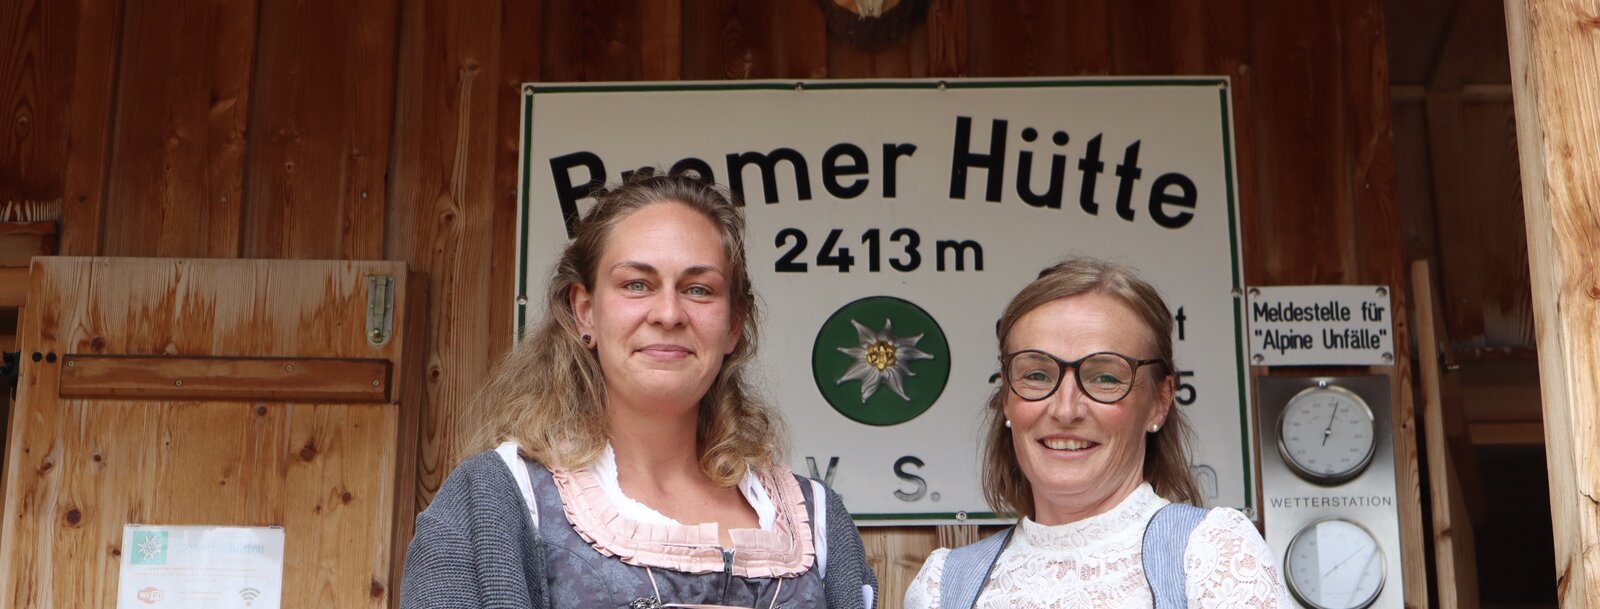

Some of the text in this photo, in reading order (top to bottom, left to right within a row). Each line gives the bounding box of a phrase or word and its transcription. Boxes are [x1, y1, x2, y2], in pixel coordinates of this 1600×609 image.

[949, 115, 1198, 230] Hütte
[774, 227, 984, 273] 2413 m
[1253, 300, 1385, 323] Meldestelle für
[1254, 328, 1387, 356] "Alpine Unfälle"
[893, 455, 941, 502] S.
[1270, 495, 1392, 509] WETTERSTATION
